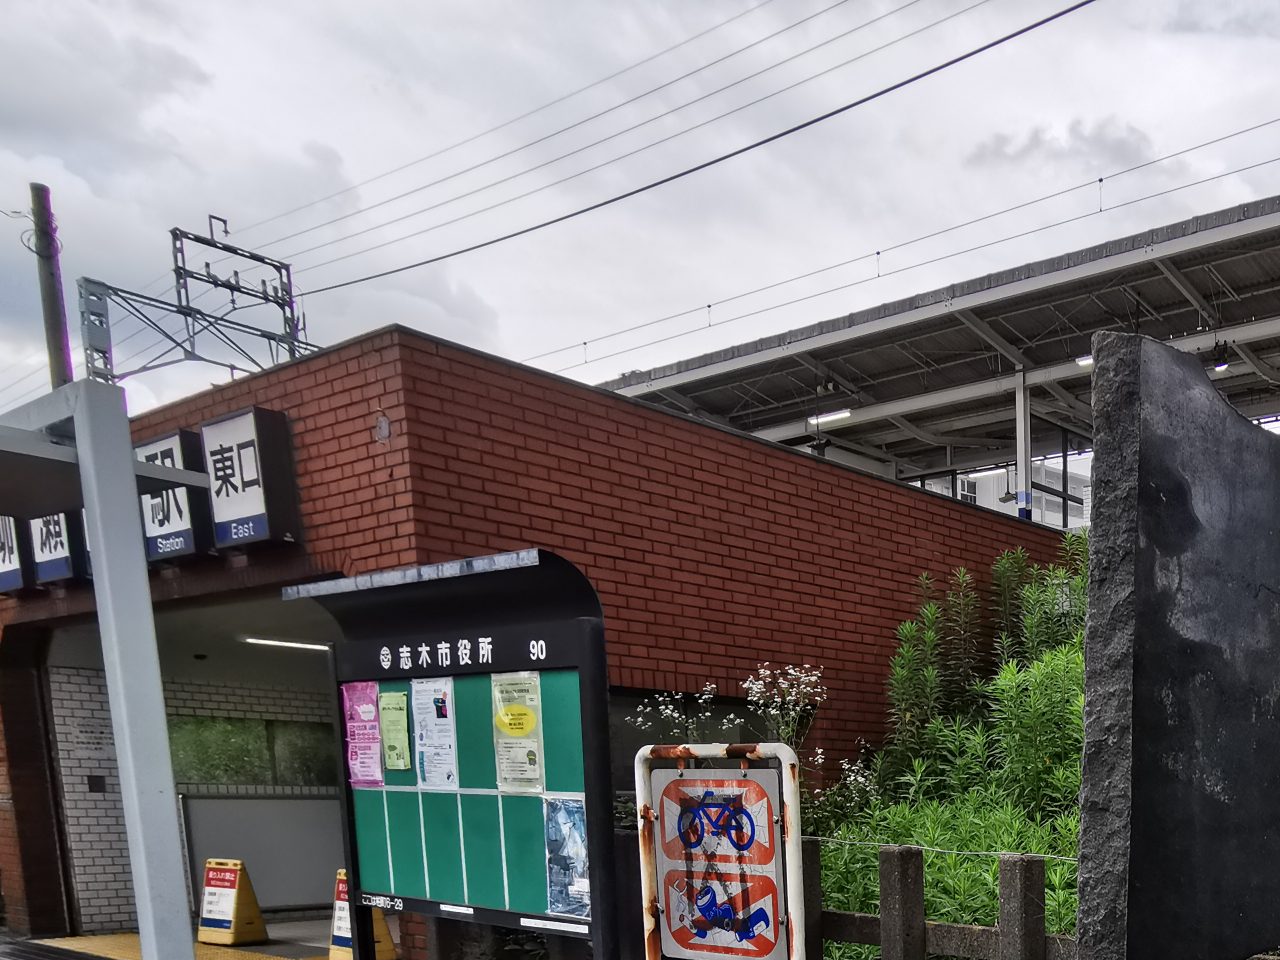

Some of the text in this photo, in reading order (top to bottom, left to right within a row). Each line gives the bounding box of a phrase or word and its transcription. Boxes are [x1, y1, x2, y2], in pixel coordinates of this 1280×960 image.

[210, 438, 262, 499] 東口
[157, 521, 254, 554] Station East
[399, 637, 547, 670] 志木市役所 90
